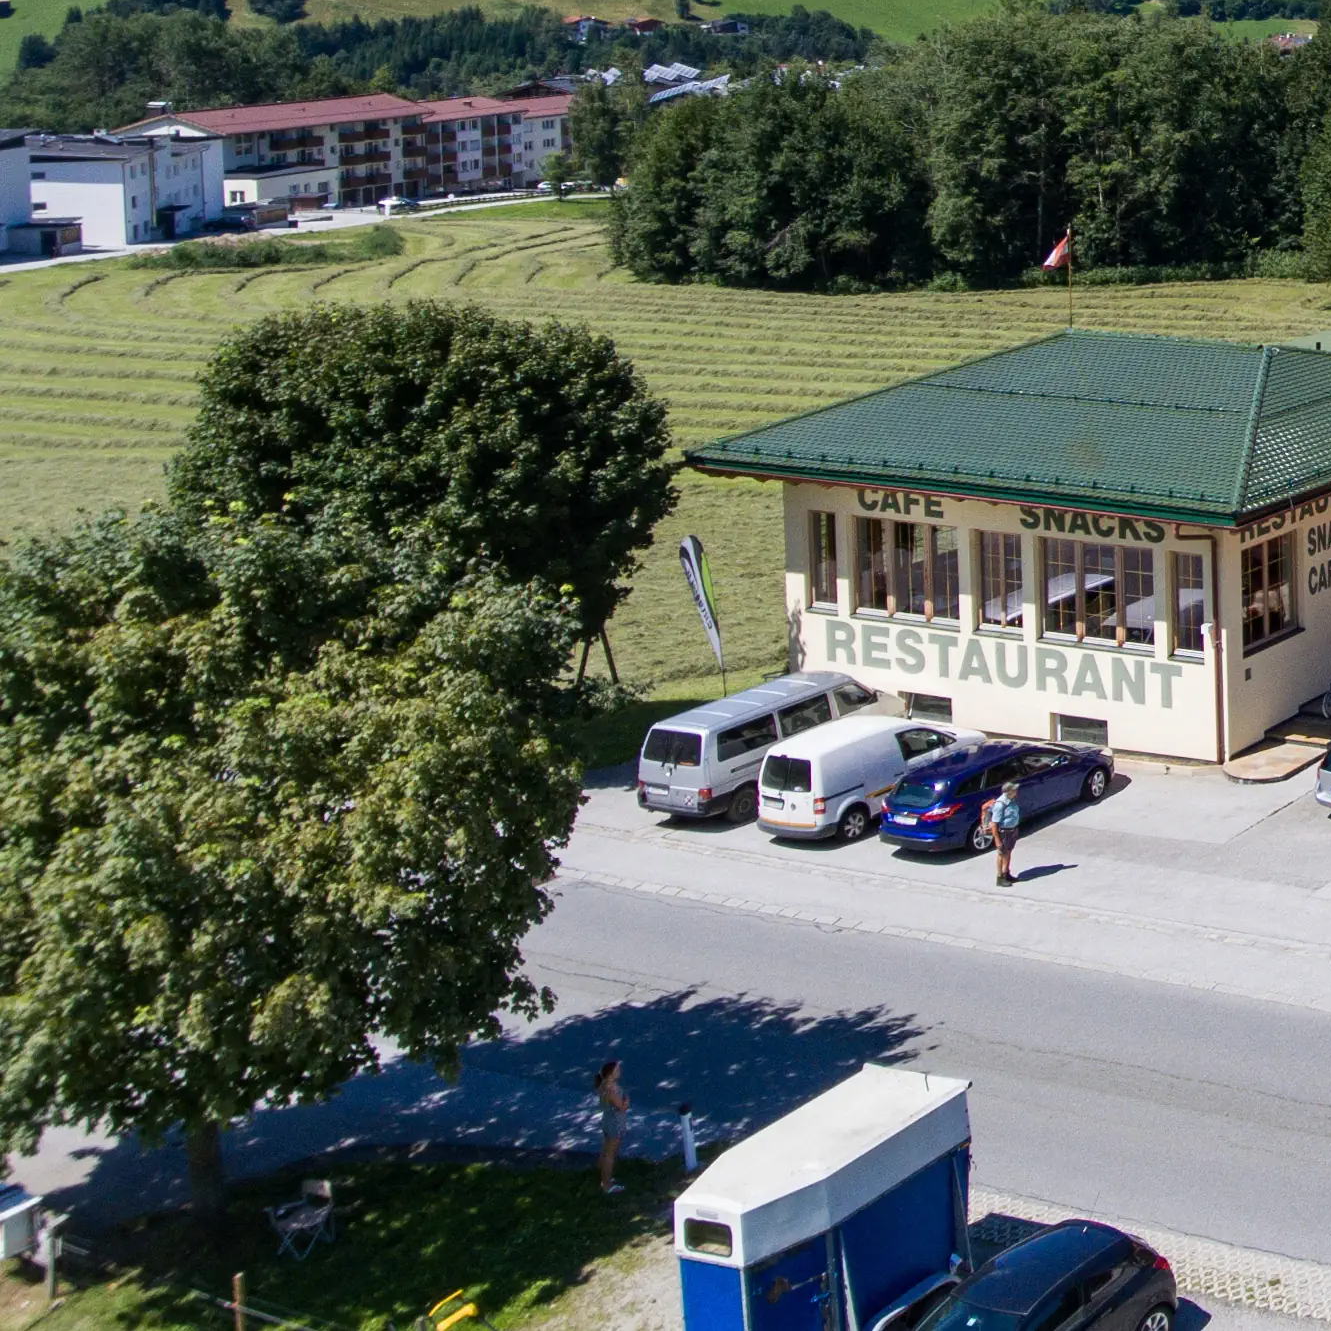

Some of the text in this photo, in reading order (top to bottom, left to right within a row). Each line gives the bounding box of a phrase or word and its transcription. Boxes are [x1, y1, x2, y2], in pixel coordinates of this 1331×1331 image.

[857, 488, 944, 519] CAFE
[1019, 506, 1166, 543] SNACKS
[825, 620, 1183, 709] RESTAURANT
